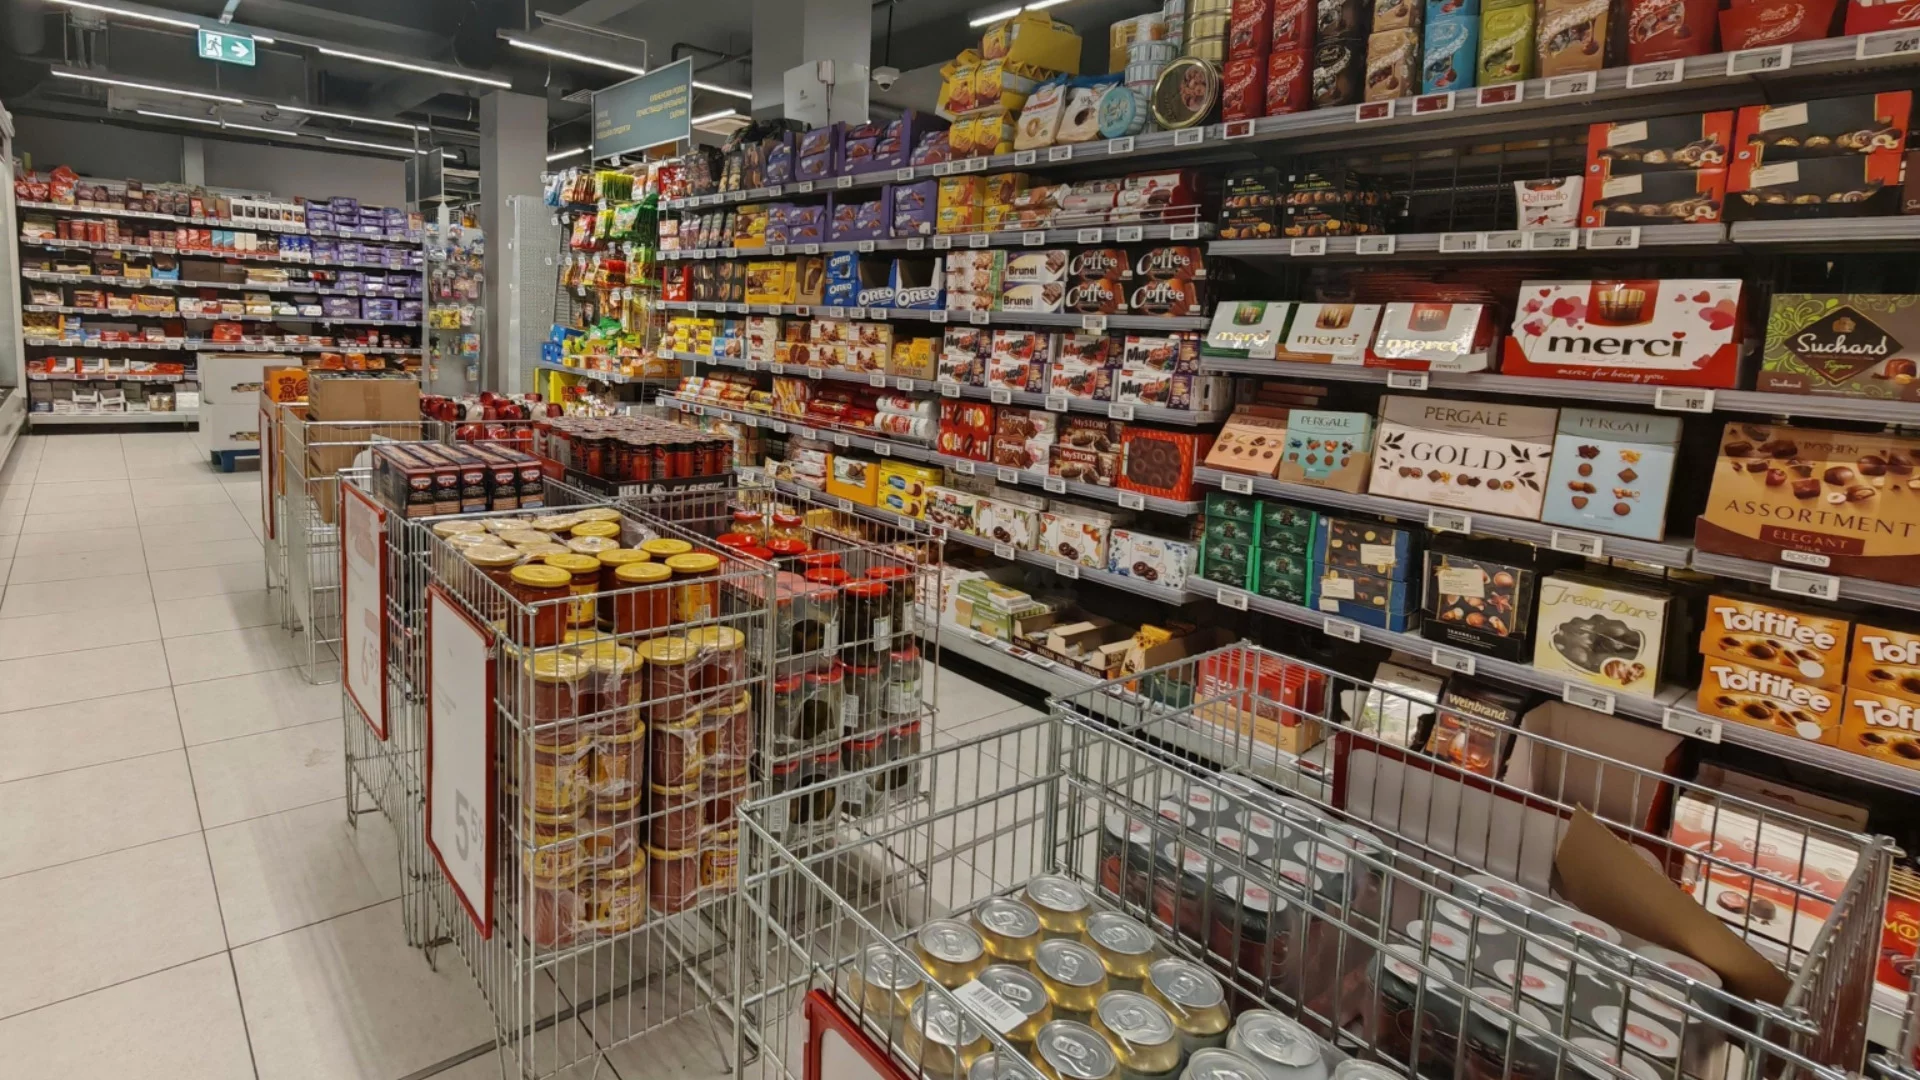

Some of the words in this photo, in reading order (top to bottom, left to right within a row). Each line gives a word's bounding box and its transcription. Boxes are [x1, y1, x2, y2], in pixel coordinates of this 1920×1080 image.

[831, 255, 851, 267] OREO
[1069, 249, 1118, 276] Coffee
[1136, 247, 1191, 275] Coffee
[829, 283, 852, 294] OREO
[858, 287, 895, 306] OREO
[897, 287, 938, 307] OREO
[1065, 283, 1114, 308] Coffee
[1130, 283, 1185, 309] Coffee
[1214, 329, 1272, 343] merci
[1297, 333, 1361, 348] merci
[1386, 337, 1460, 352] merci
[1547, 331, 1687, 358] merci
[1797, 332, 1888, 355] Suchard
[1611, 369, 1641, 383] being
[1411, 441, 1507, 471] GOLD
[1724, 499, 1917, 539] ASSORTMENT
[1773, 529, 1849, 550] ELEGANT
[1713, 606, 1836, 650] Toffifee
[1709, 665, 1831, 712] Toffifee
